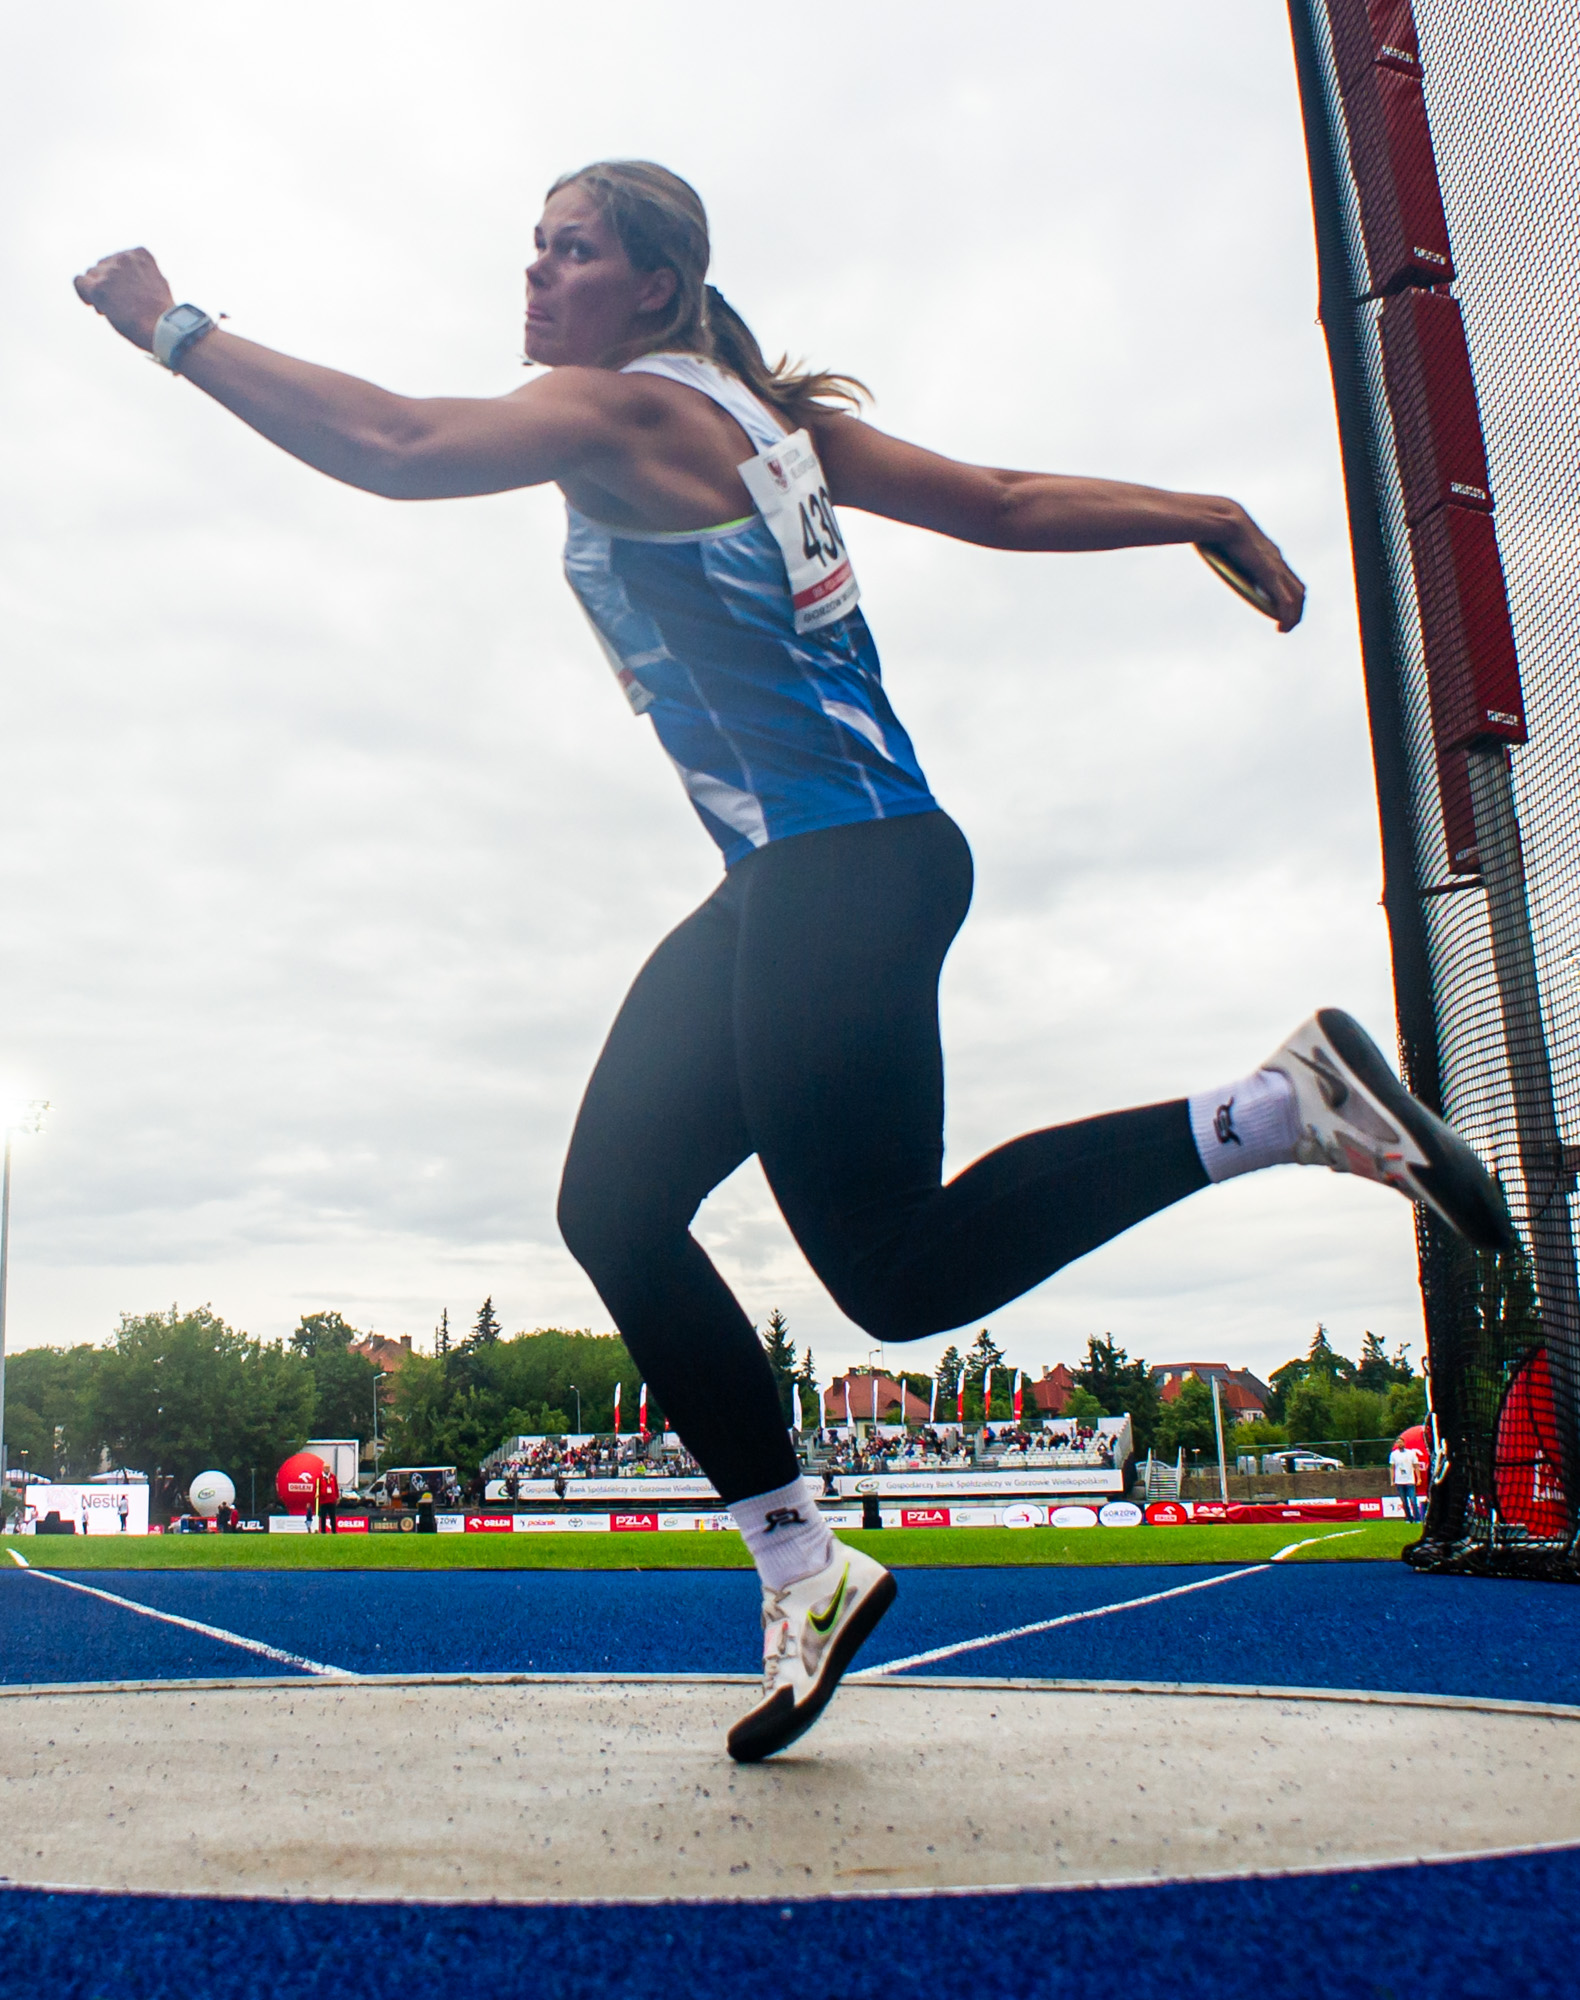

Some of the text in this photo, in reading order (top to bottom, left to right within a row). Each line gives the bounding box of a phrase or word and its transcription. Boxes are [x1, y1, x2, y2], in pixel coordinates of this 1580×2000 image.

[616, 1515, 652, 1525] PZLA
[907, 1511, 944, 1521] PZLA
[337, 1520, 365, 1528] ORLEN
[484, 1519, 511, 1527] ORLEN
